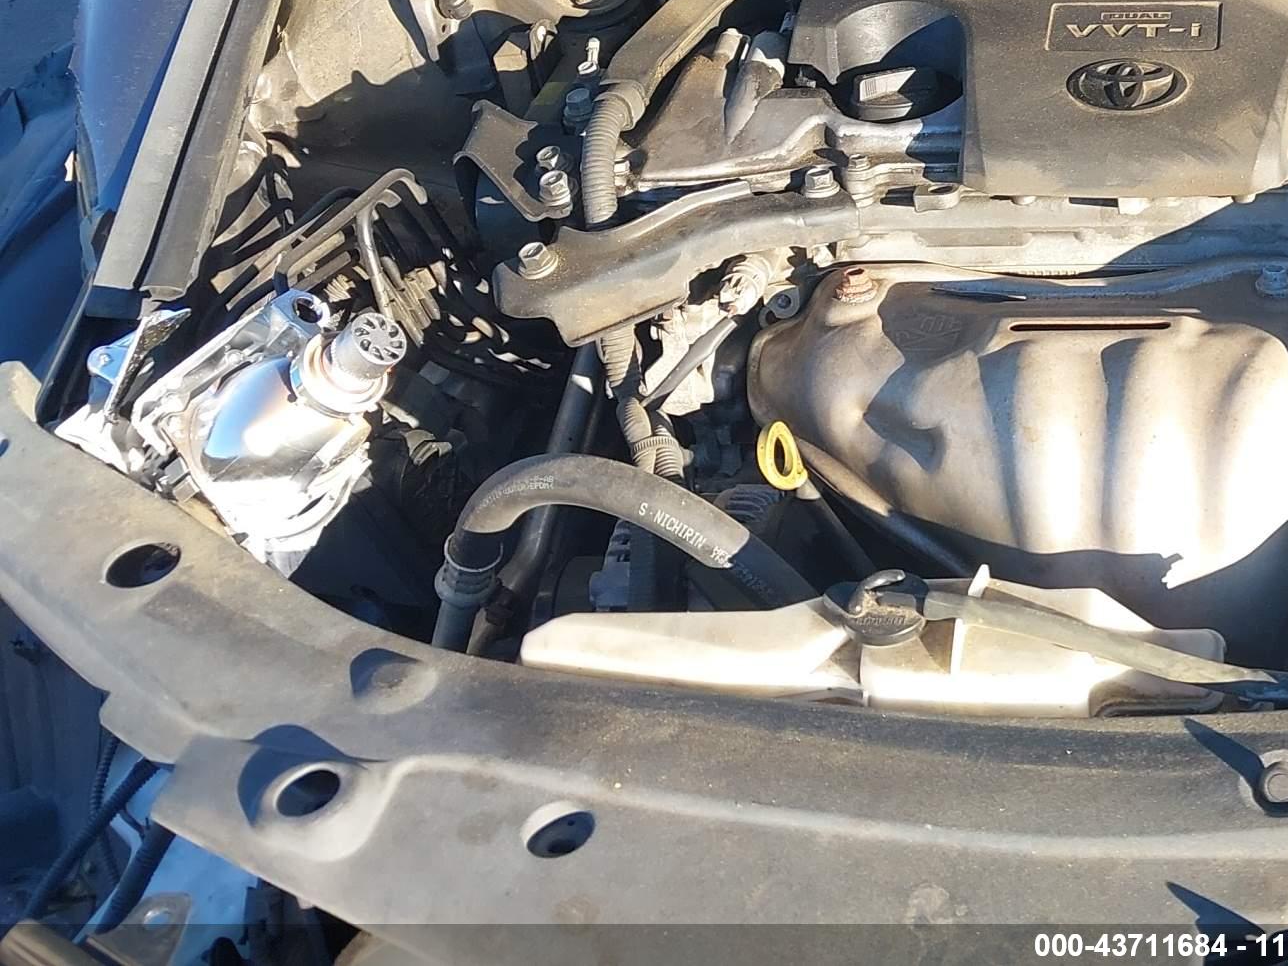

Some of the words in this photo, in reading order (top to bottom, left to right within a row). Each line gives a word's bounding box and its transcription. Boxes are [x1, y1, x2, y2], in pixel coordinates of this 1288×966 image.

[1109, 12, 1170, 21] DUAL
[1065, 22, 1202, 38] VVT-i
[638, 502, 648, 516] S
[653, 509, 708, 548] NICHIRIN
